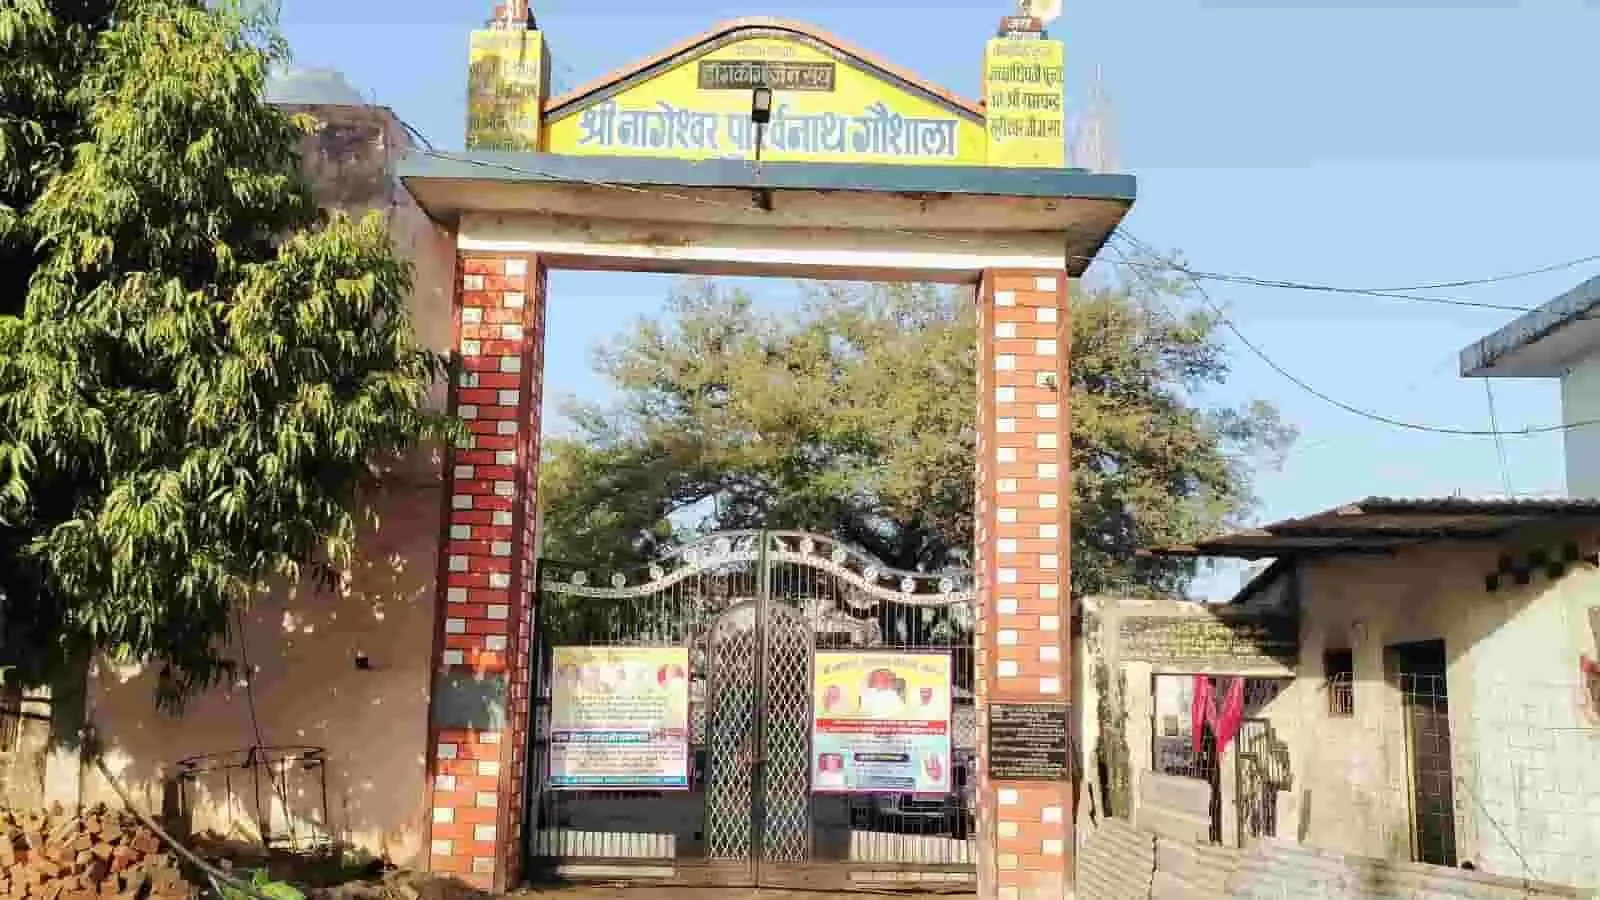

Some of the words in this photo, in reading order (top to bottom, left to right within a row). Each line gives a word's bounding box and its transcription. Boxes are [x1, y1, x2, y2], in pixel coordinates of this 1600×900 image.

[577, 101, 616, 146] श्री
[618, 100, 718, 150] नागेश्वर
[852, 101, 958, 156] गौशाला
